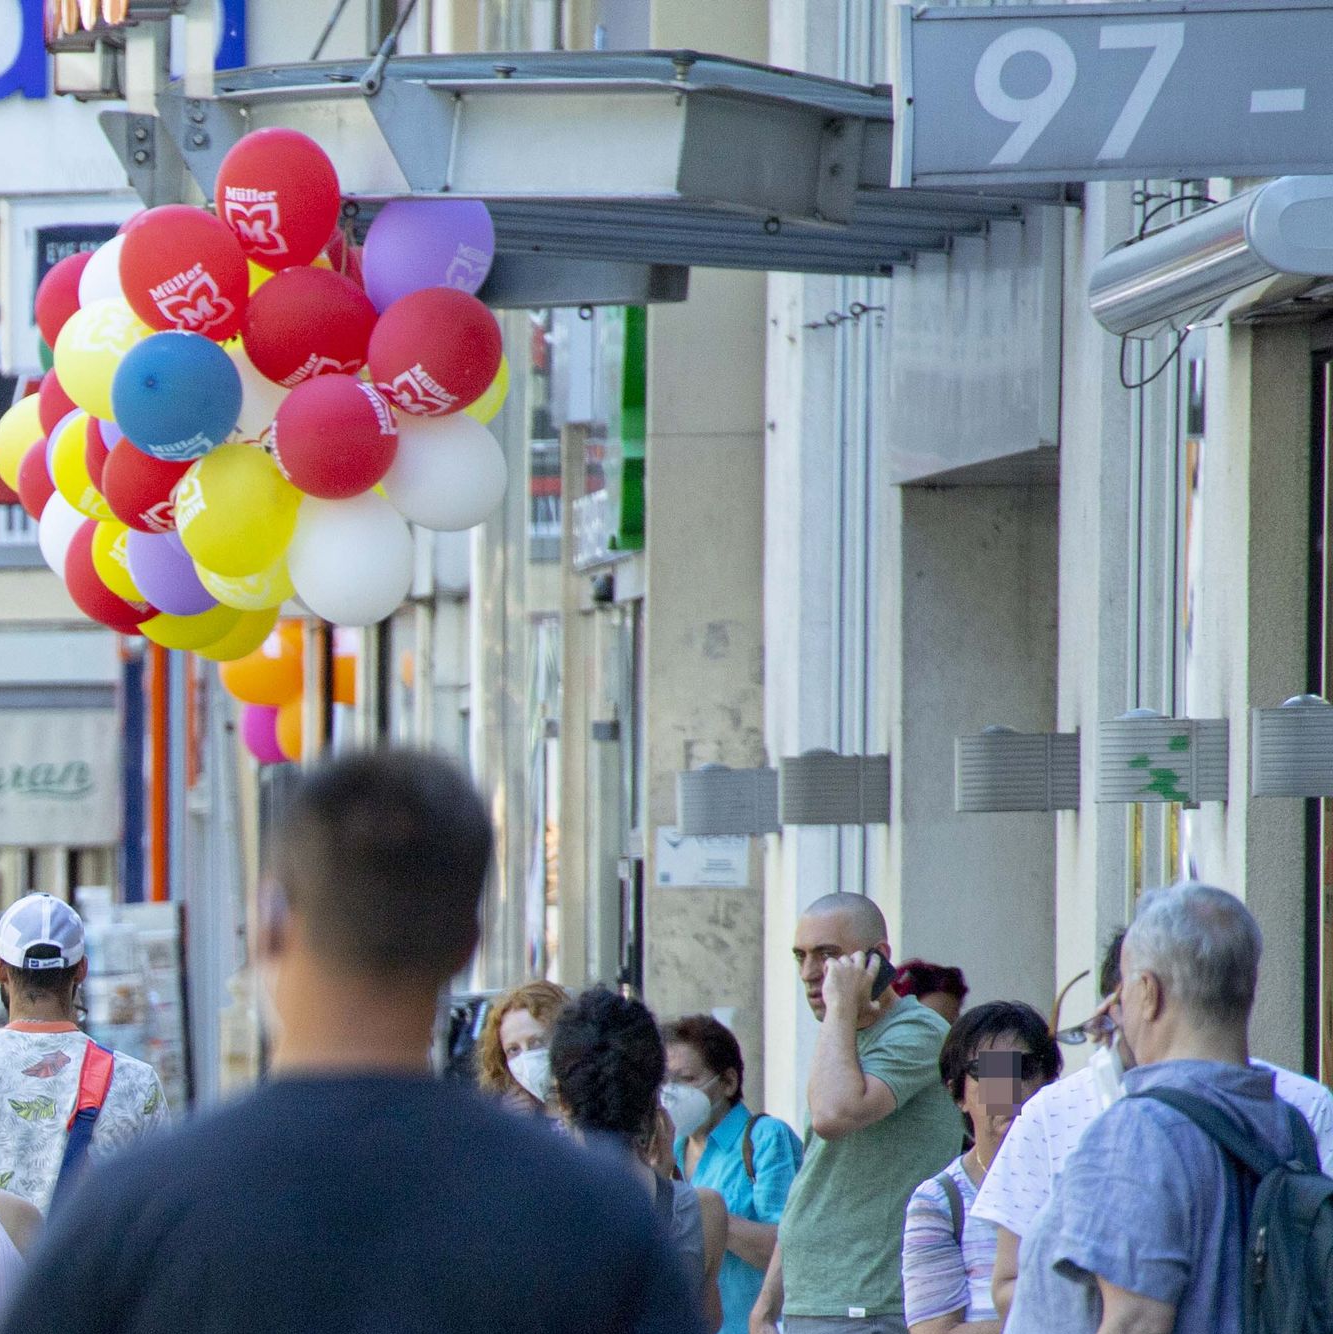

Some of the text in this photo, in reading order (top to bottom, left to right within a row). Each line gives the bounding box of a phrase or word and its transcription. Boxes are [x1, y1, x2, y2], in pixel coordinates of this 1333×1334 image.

[974, 23, 1185, 164] 97
[225, 185, 277, 202] Müller
[148, 262, 204, 301] Müller
[410, 363, 460, 401] Müller
